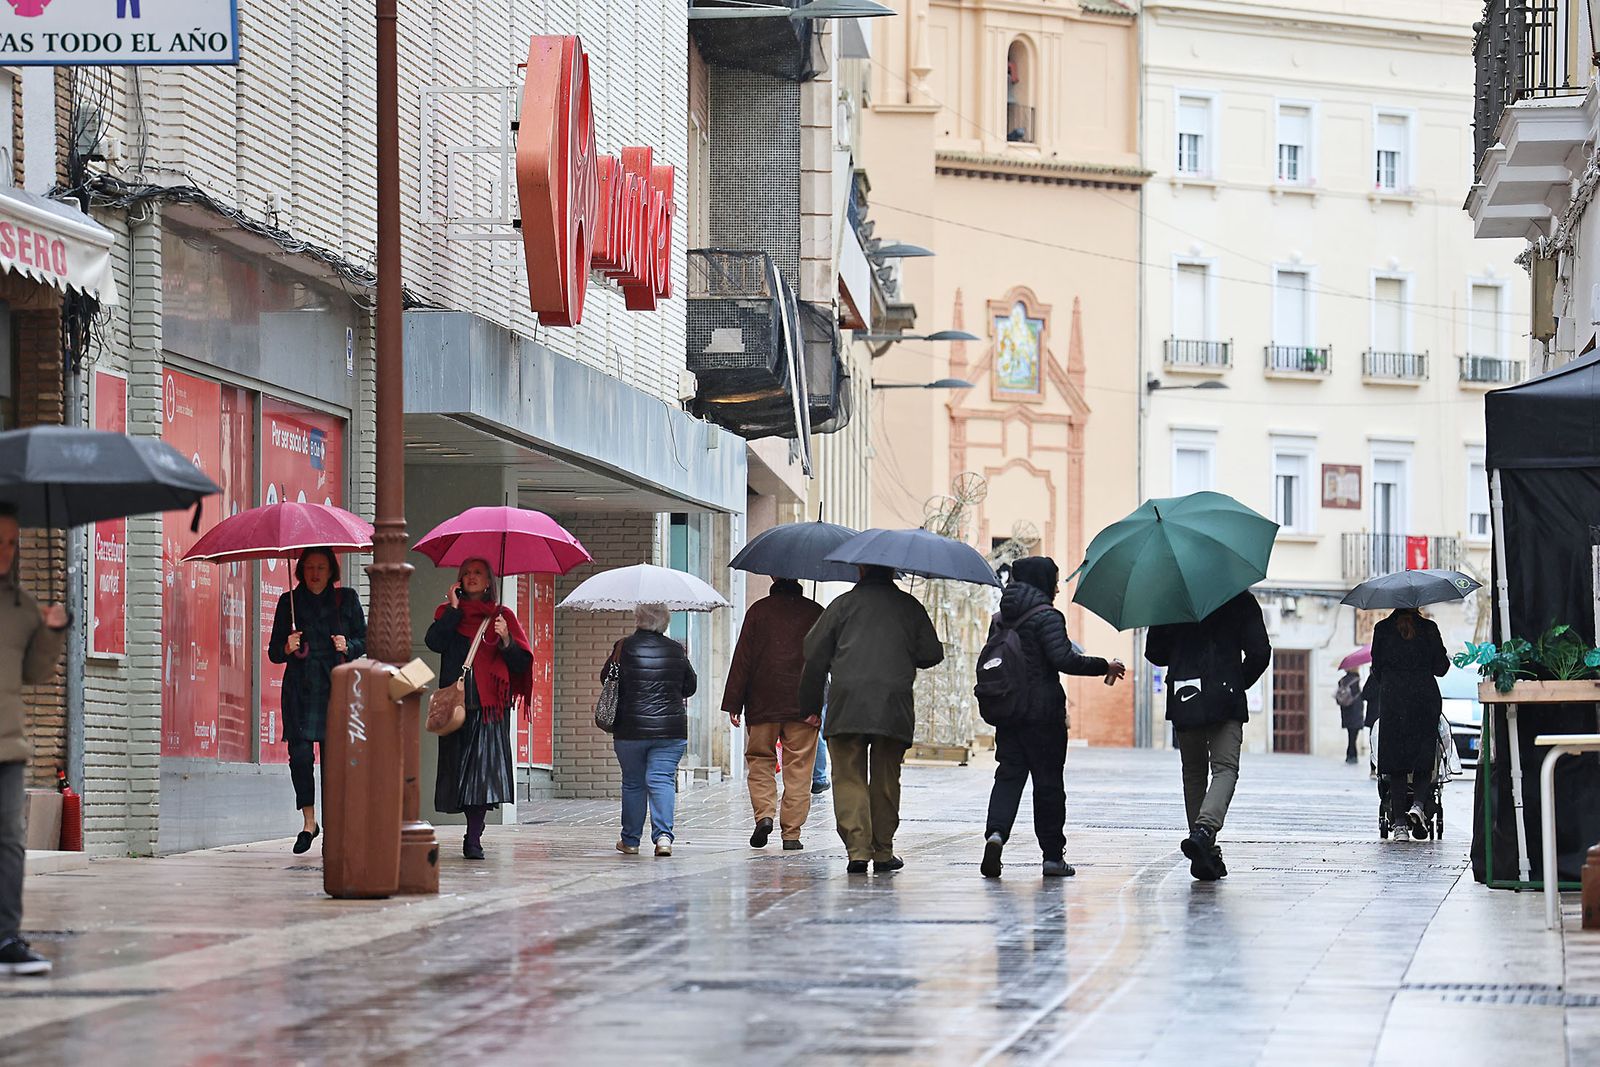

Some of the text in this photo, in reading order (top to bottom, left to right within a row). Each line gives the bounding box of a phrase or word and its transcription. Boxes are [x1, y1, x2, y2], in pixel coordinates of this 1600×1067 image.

[0, 27, 228, 52] AS TODO EL AÑO
[271, 420, 309, 455] Por ser socio de
[95, 532, 124, 562] Carrefour
[99, 569, 120, 596] market
